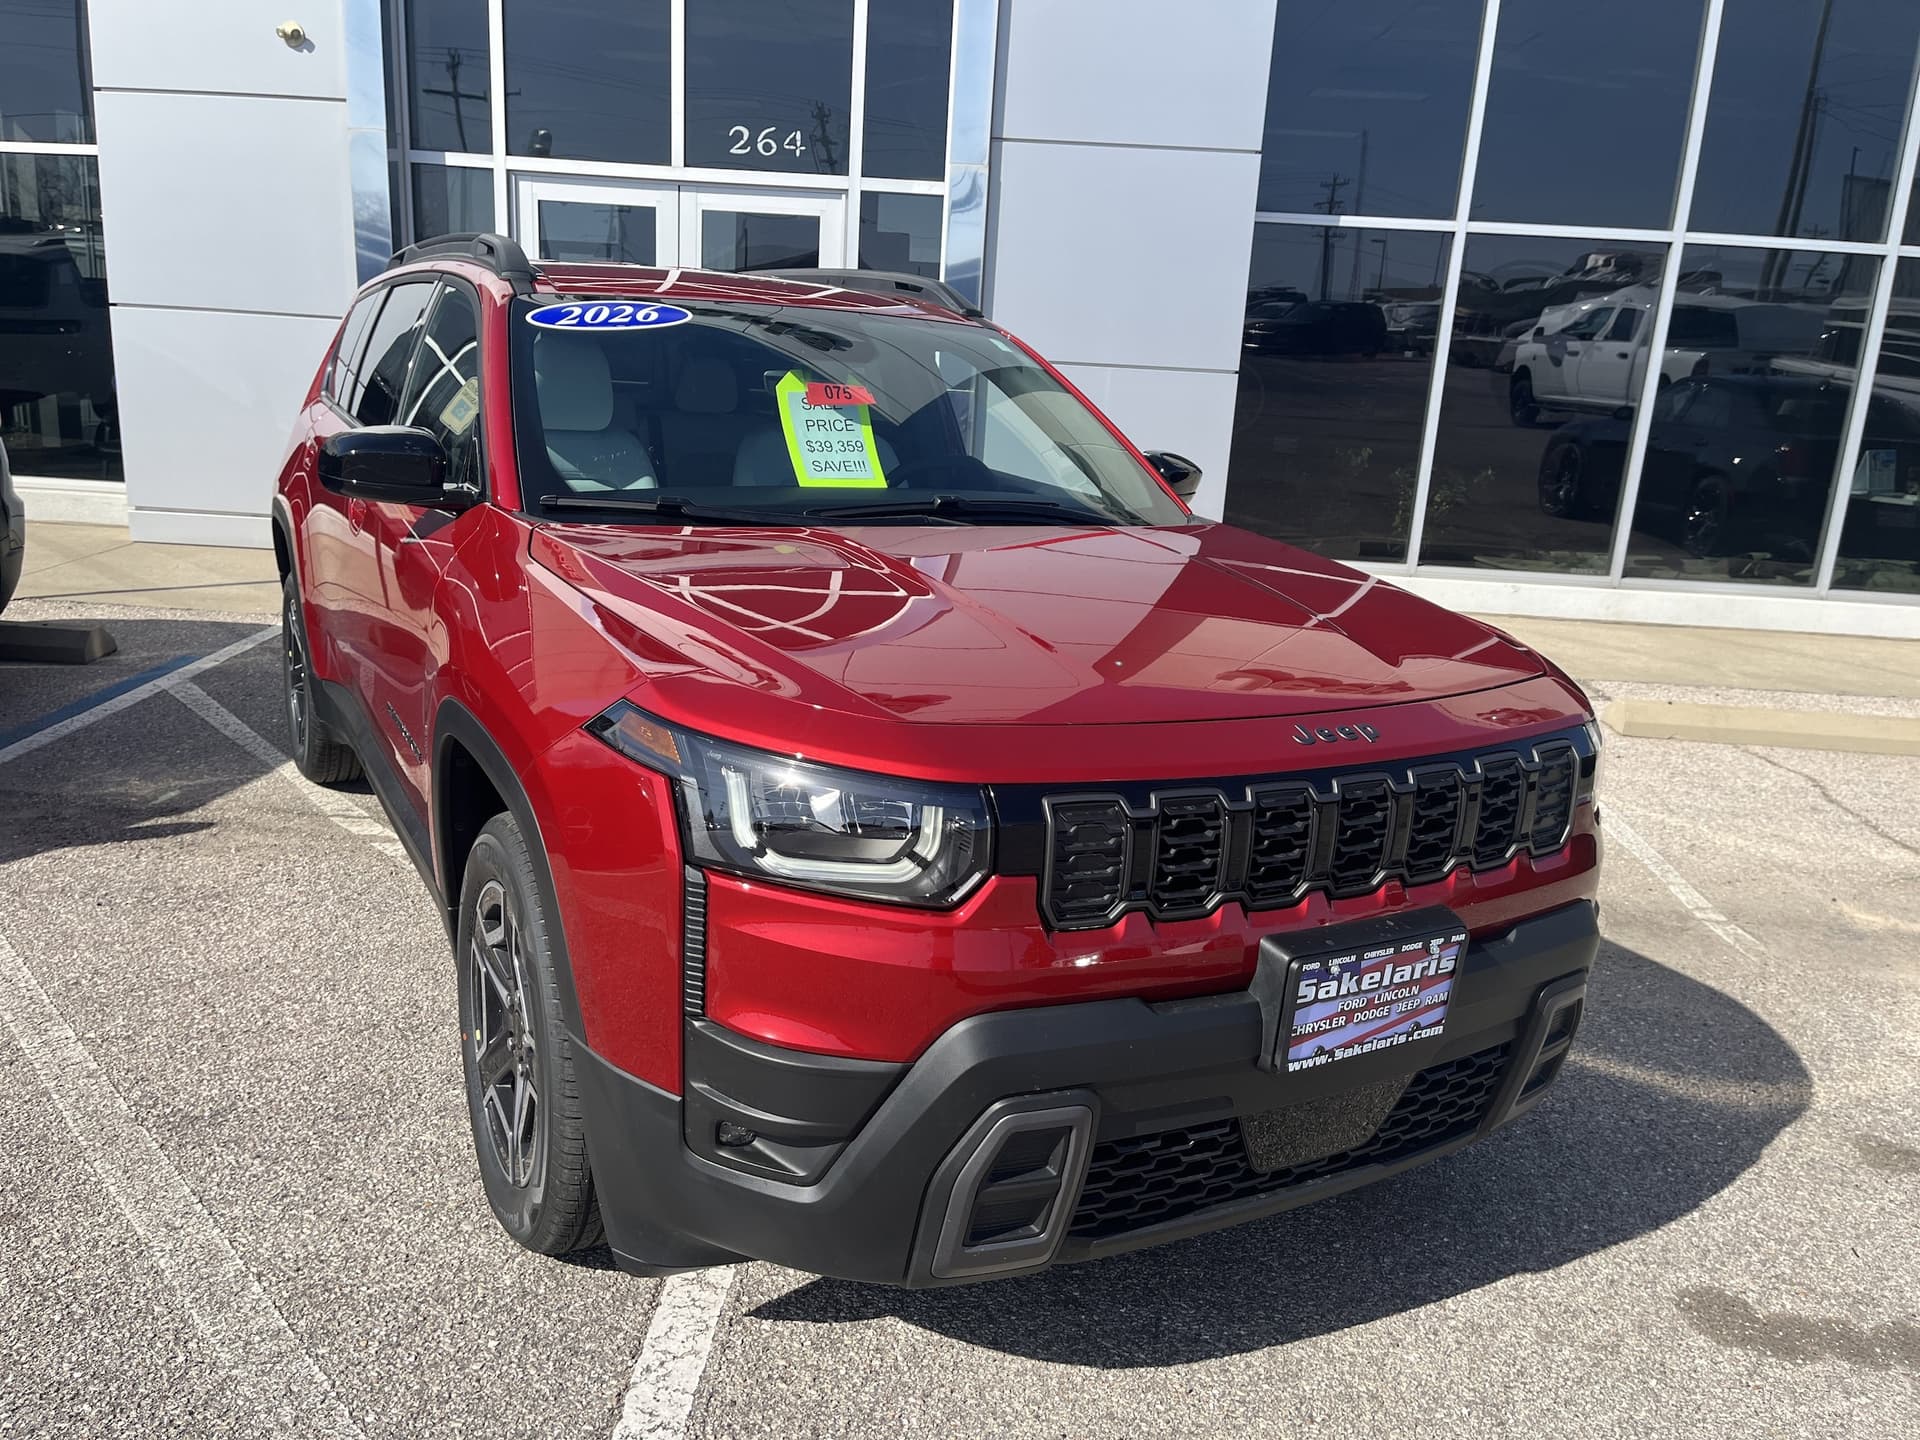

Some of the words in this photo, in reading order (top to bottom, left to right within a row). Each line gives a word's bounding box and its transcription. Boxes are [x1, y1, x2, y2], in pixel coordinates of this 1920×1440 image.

[728, 125, 806, 157] 264
[555, 305, 662, 325] 2026
[824, 385, 852, 400] 075
[805, 419, 855, 432] PRICE
[805, 440, 864, 454] $39,359
[812, 460, 867, 473] SAVE!!!
[1292, 723, 1380, 745] Jeep
[1302, 962, 1321, 972] FORD
[1328, 955, 1357, 966] LINCOLN
[1364, 947, 1395, 959] CHRYSLER
[1401, 942, 1424, 952] DODGE
[1430, 938, 1445, 947] JEEP
[1451, 934, 1466, 942] RAM
[1296, 955, 1457, 1004] Sakelaris
[1337, 997, 1367, 1012] FORD
[1374, 985, 1420, 1004] LINCOLN
[1291, 1016, 1346, 1036] CHRYSLER
[1353, 1006, 1390, 1023] DODGE
[1396, 998, 1420, 1013] JEEP
[1424, 992, 1449, 1005] RAM
[1287, 1025, 1444, 1073] www.Sakelaris.com
